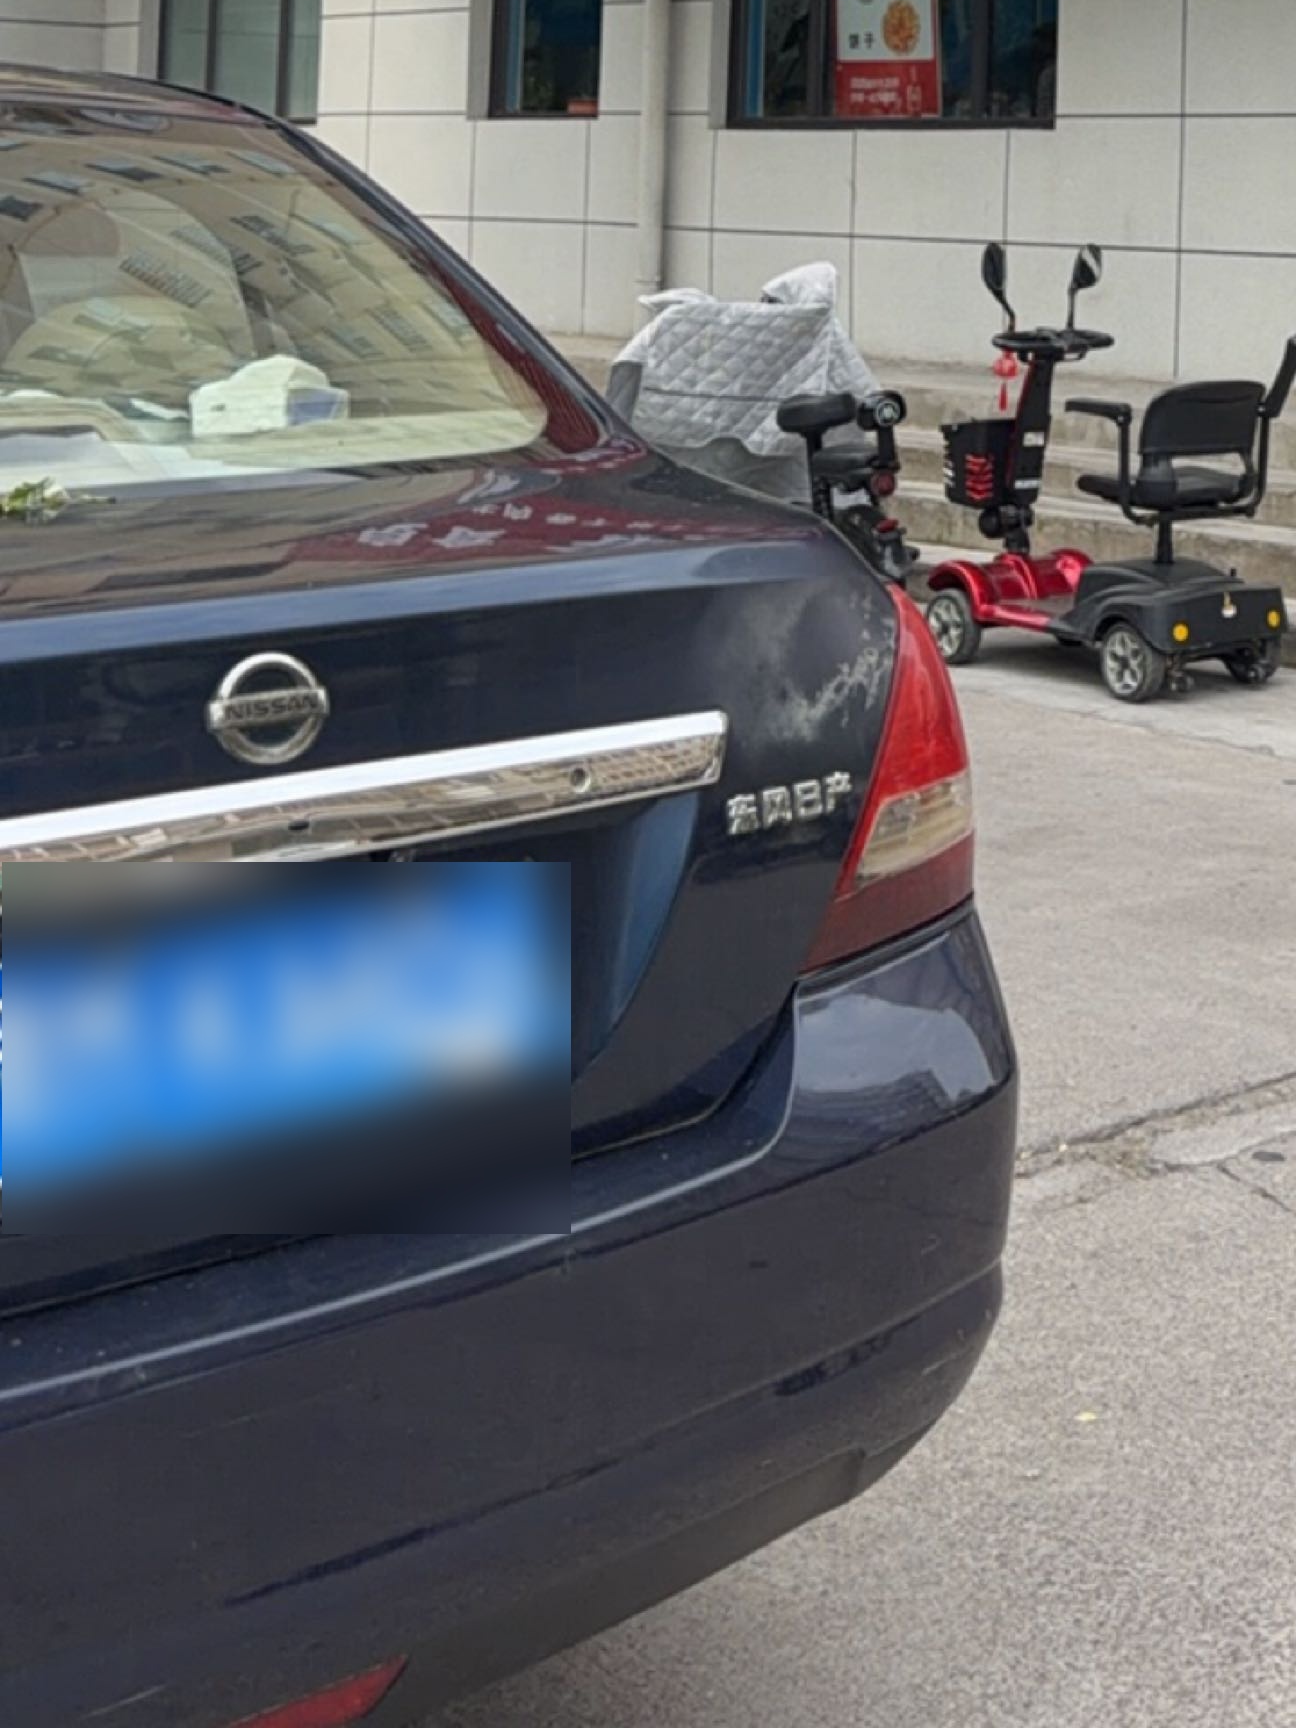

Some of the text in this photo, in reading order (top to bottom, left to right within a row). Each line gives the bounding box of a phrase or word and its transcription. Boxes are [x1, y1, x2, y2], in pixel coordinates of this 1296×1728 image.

[224, 695, 319, 721] NISSAN
[726, 771, 853, 835] 东风日产
